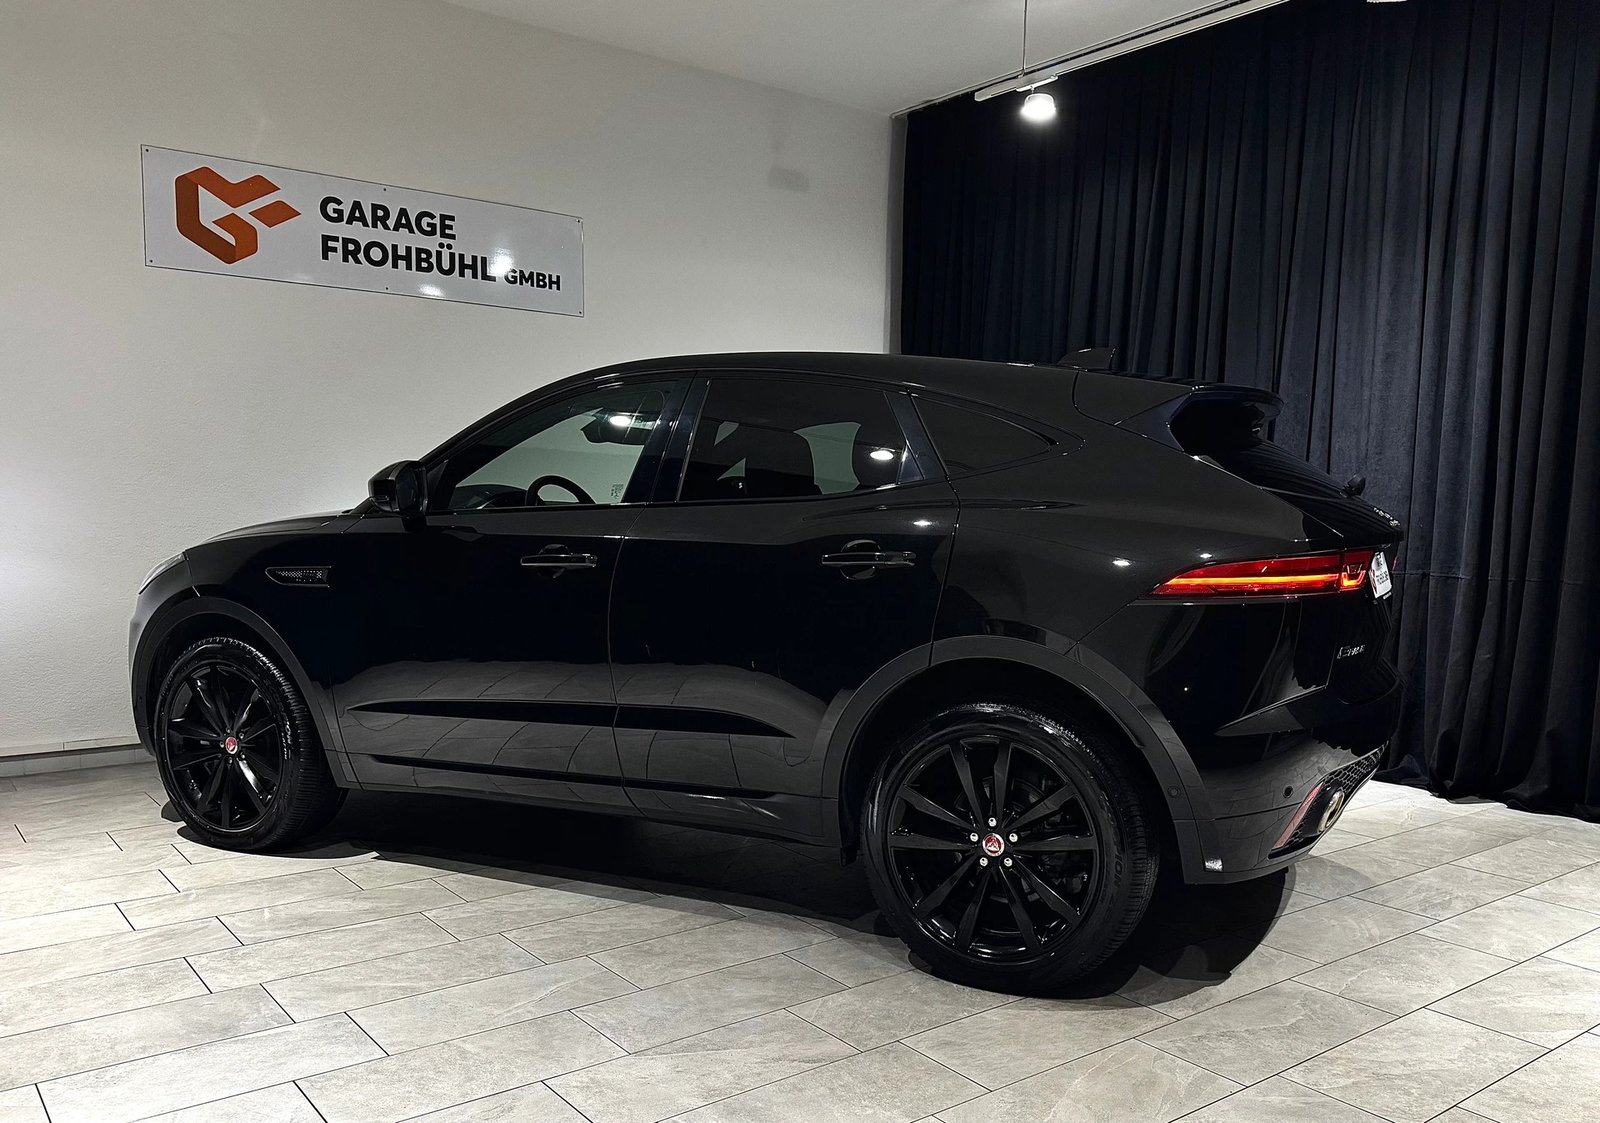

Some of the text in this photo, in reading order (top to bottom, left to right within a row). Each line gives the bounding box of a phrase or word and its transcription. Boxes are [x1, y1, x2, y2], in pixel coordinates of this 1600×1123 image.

[319, 195, 457, 241] GARAGE
[321, 233, 561, 292] FROHBÜHL GMBH
